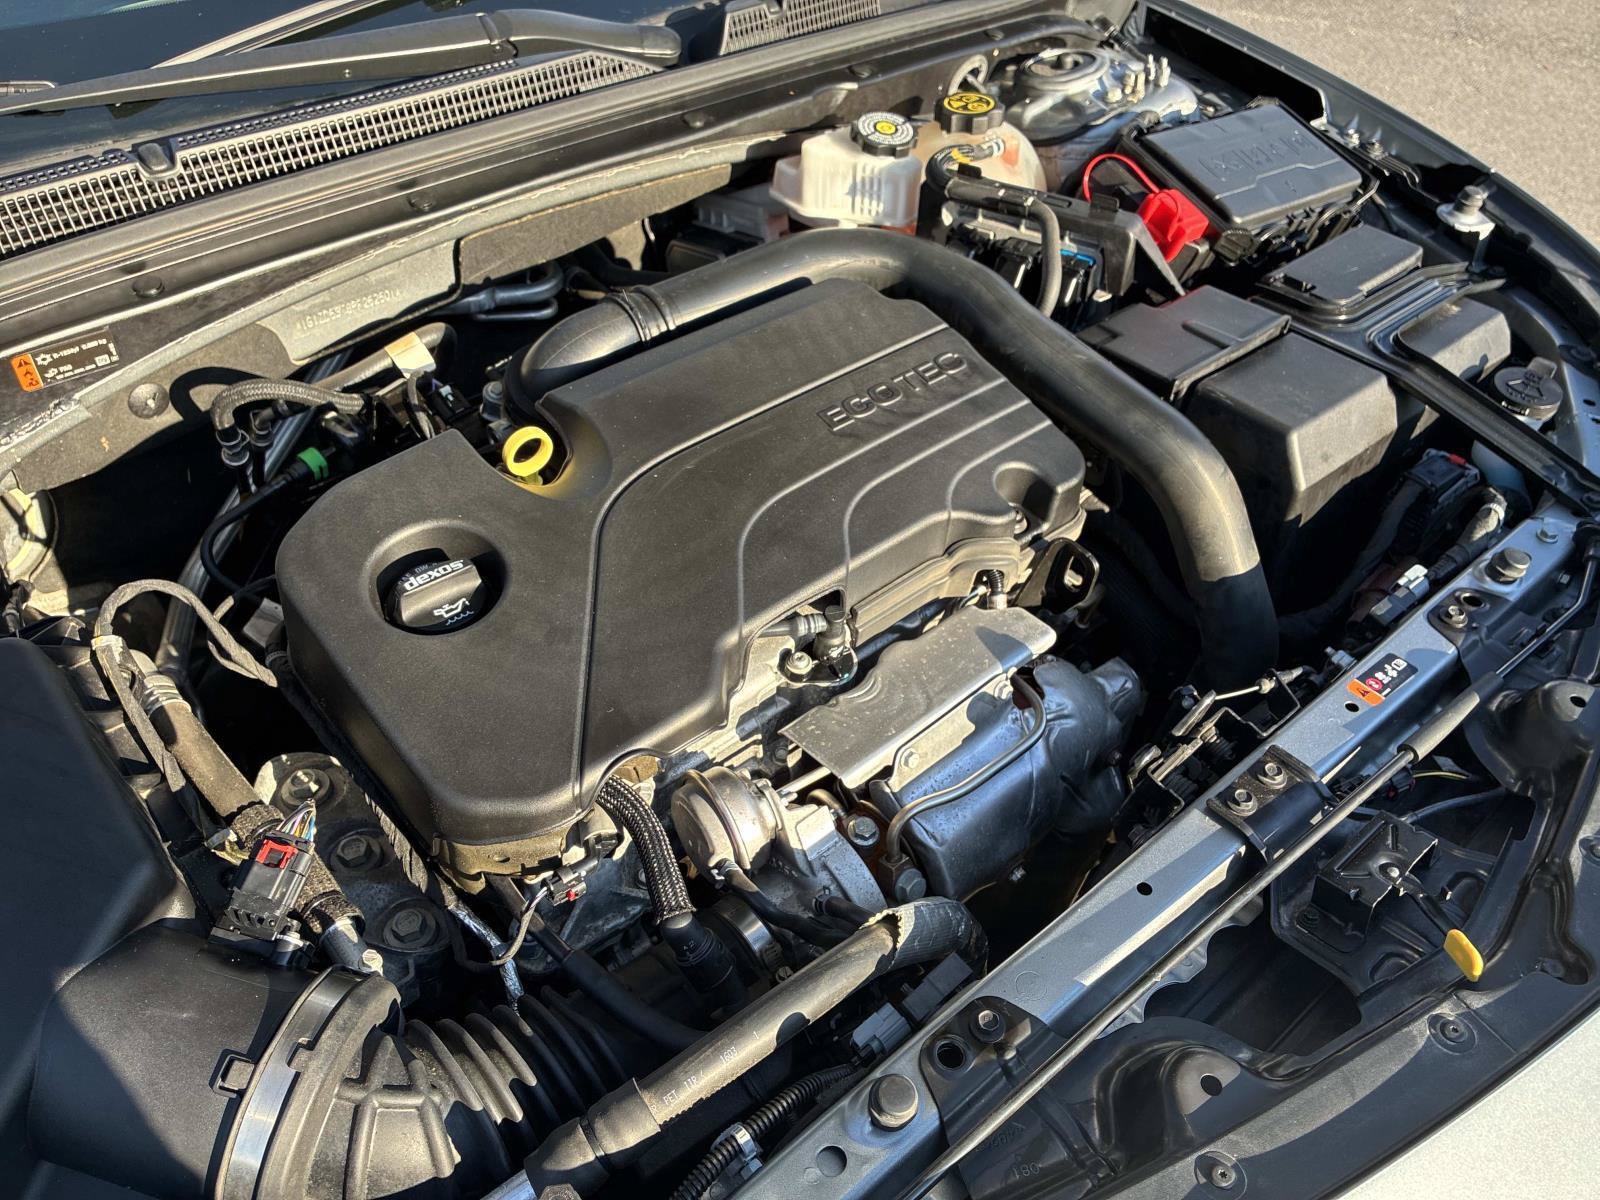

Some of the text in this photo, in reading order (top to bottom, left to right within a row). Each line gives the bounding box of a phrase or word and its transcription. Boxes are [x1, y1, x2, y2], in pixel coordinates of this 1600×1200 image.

[815, 351, 968, 433] ECOTEC
[403, 560, 464, 591] dexos
[663, 1089, 681, 1106] PET
